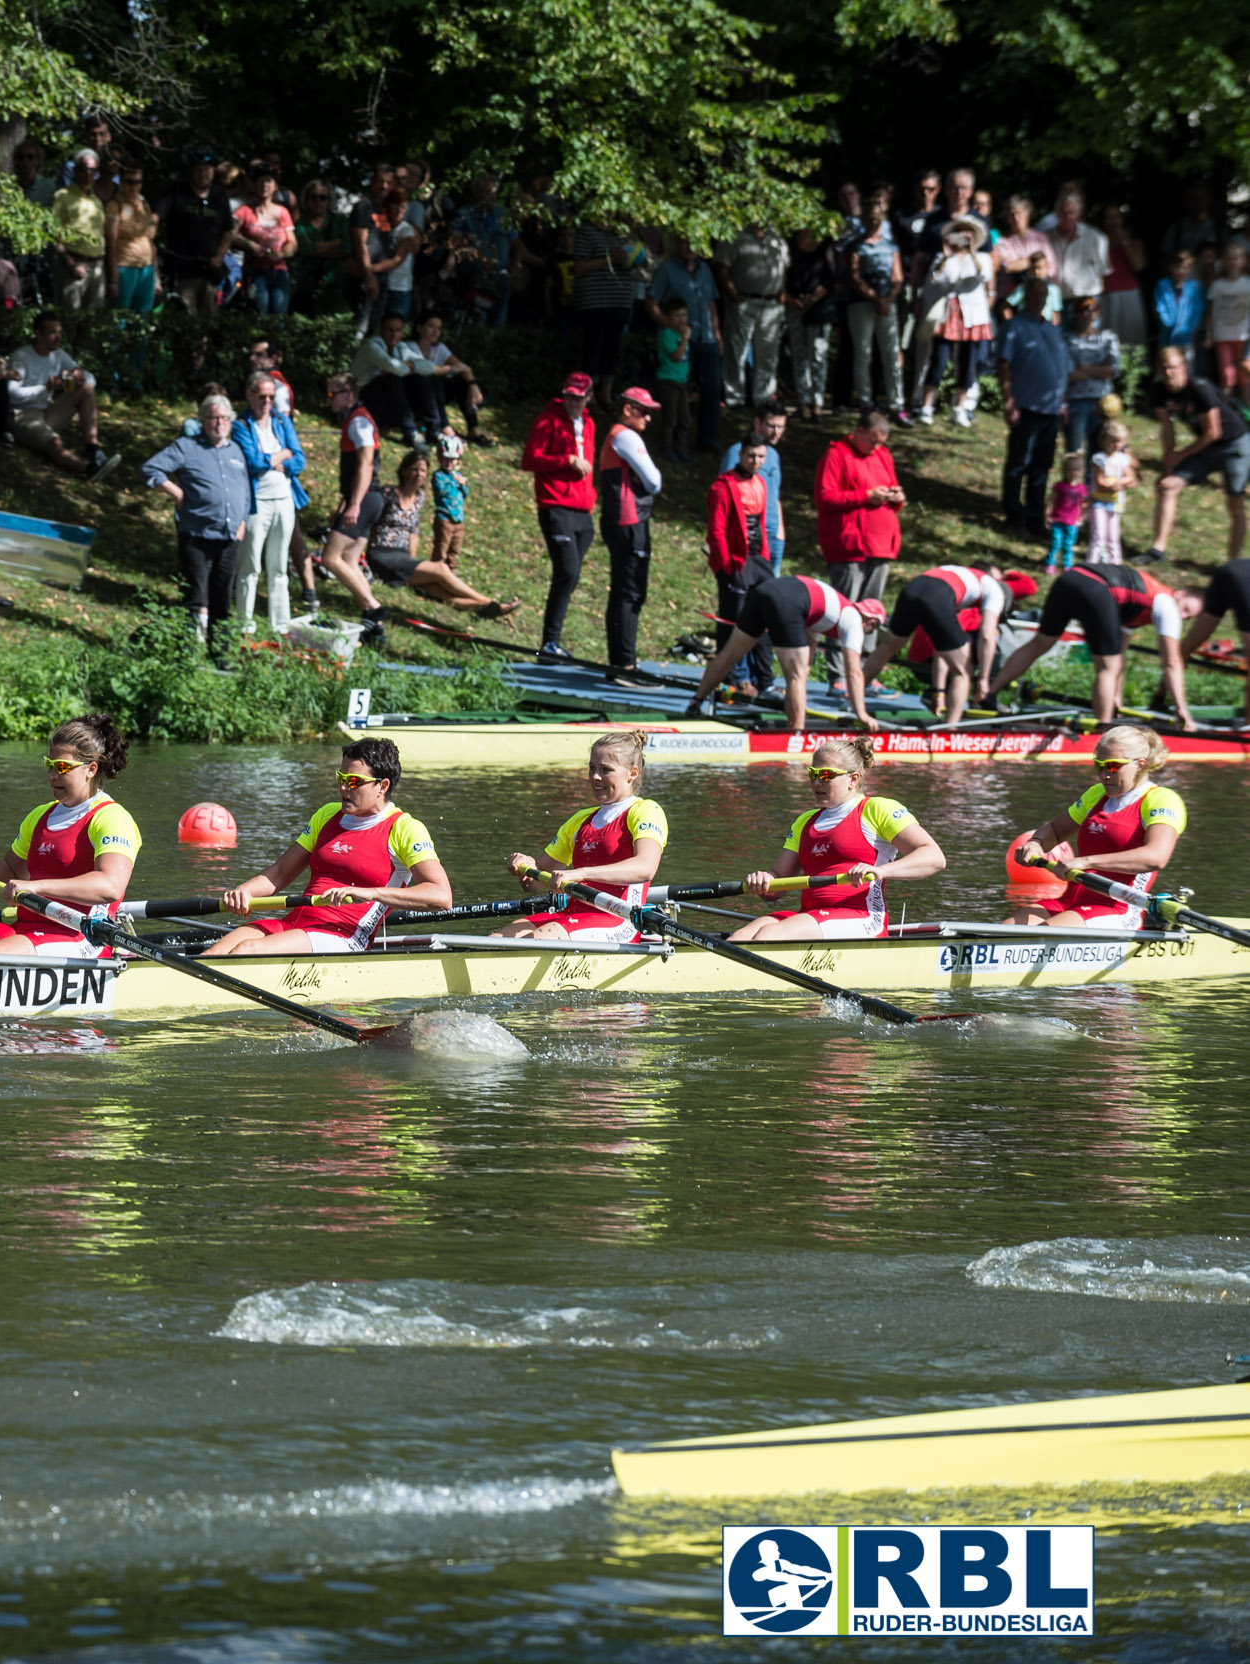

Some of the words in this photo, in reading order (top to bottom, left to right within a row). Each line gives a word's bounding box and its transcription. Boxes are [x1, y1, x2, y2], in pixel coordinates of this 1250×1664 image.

[355, 692, 364, 715] 5
[471, 904, 489, 913] GUT.
[795, 944, 835, 972] Melitta
[961, 944, 999, 966] RBL
[1004, 946, 1123, 965] RUDER-BUNDESLIGA
[1133, 941, 1144, 957] Z
[1147, 941, 1166, 957] BS
[276, 959, 323, 991] Melitta
[548, 951, 593, 980] Melitta
